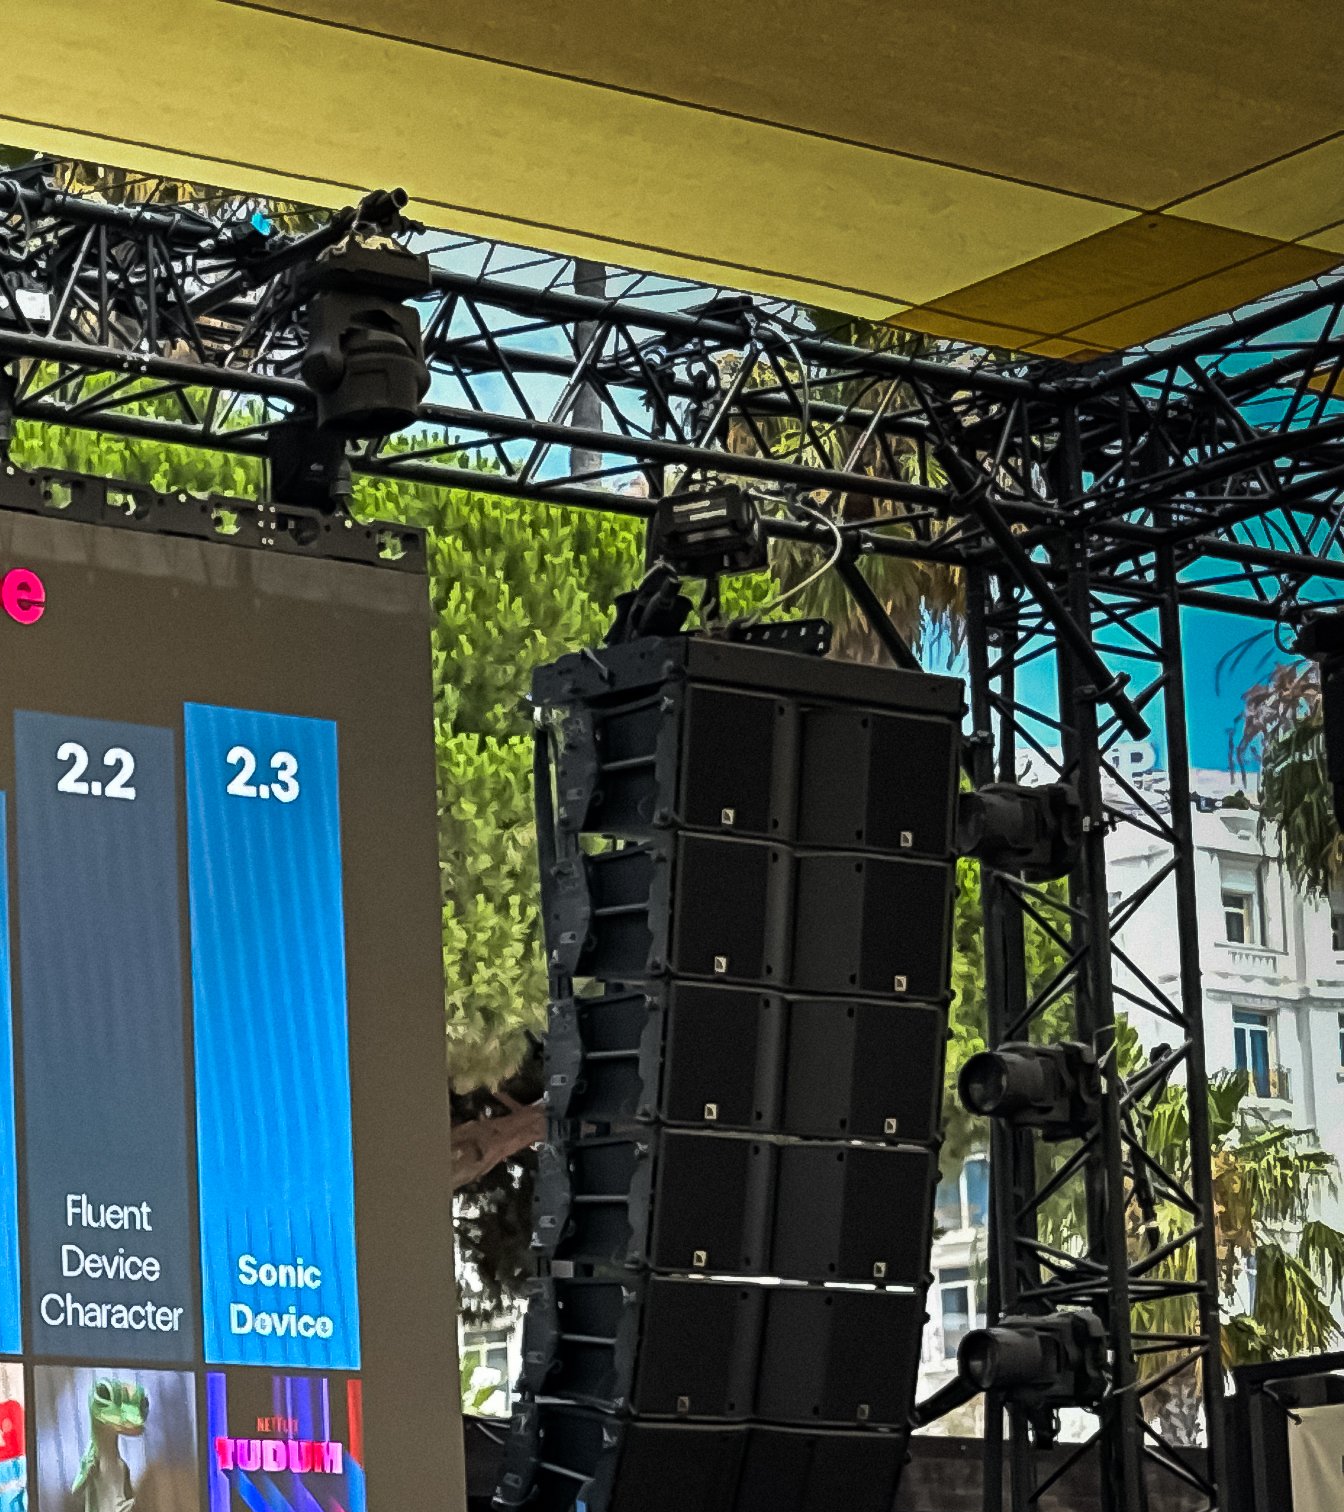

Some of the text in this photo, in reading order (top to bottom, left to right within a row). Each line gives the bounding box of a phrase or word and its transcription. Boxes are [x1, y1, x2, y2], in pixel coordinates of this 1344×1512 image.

[57, 742, 136, 800] 2.2
[226, 746, 299, 803] 2.3
[66, 1193, 153, 1231] Fluent
[61, 1244, 161, 1282] Device
[238, 1254, 321, 1288] Sonic
[40, 1292, 184, 1332] Character
[230, 1303, 333, 1337] Device
[215, 1436, 343, 1475] TUDUM
